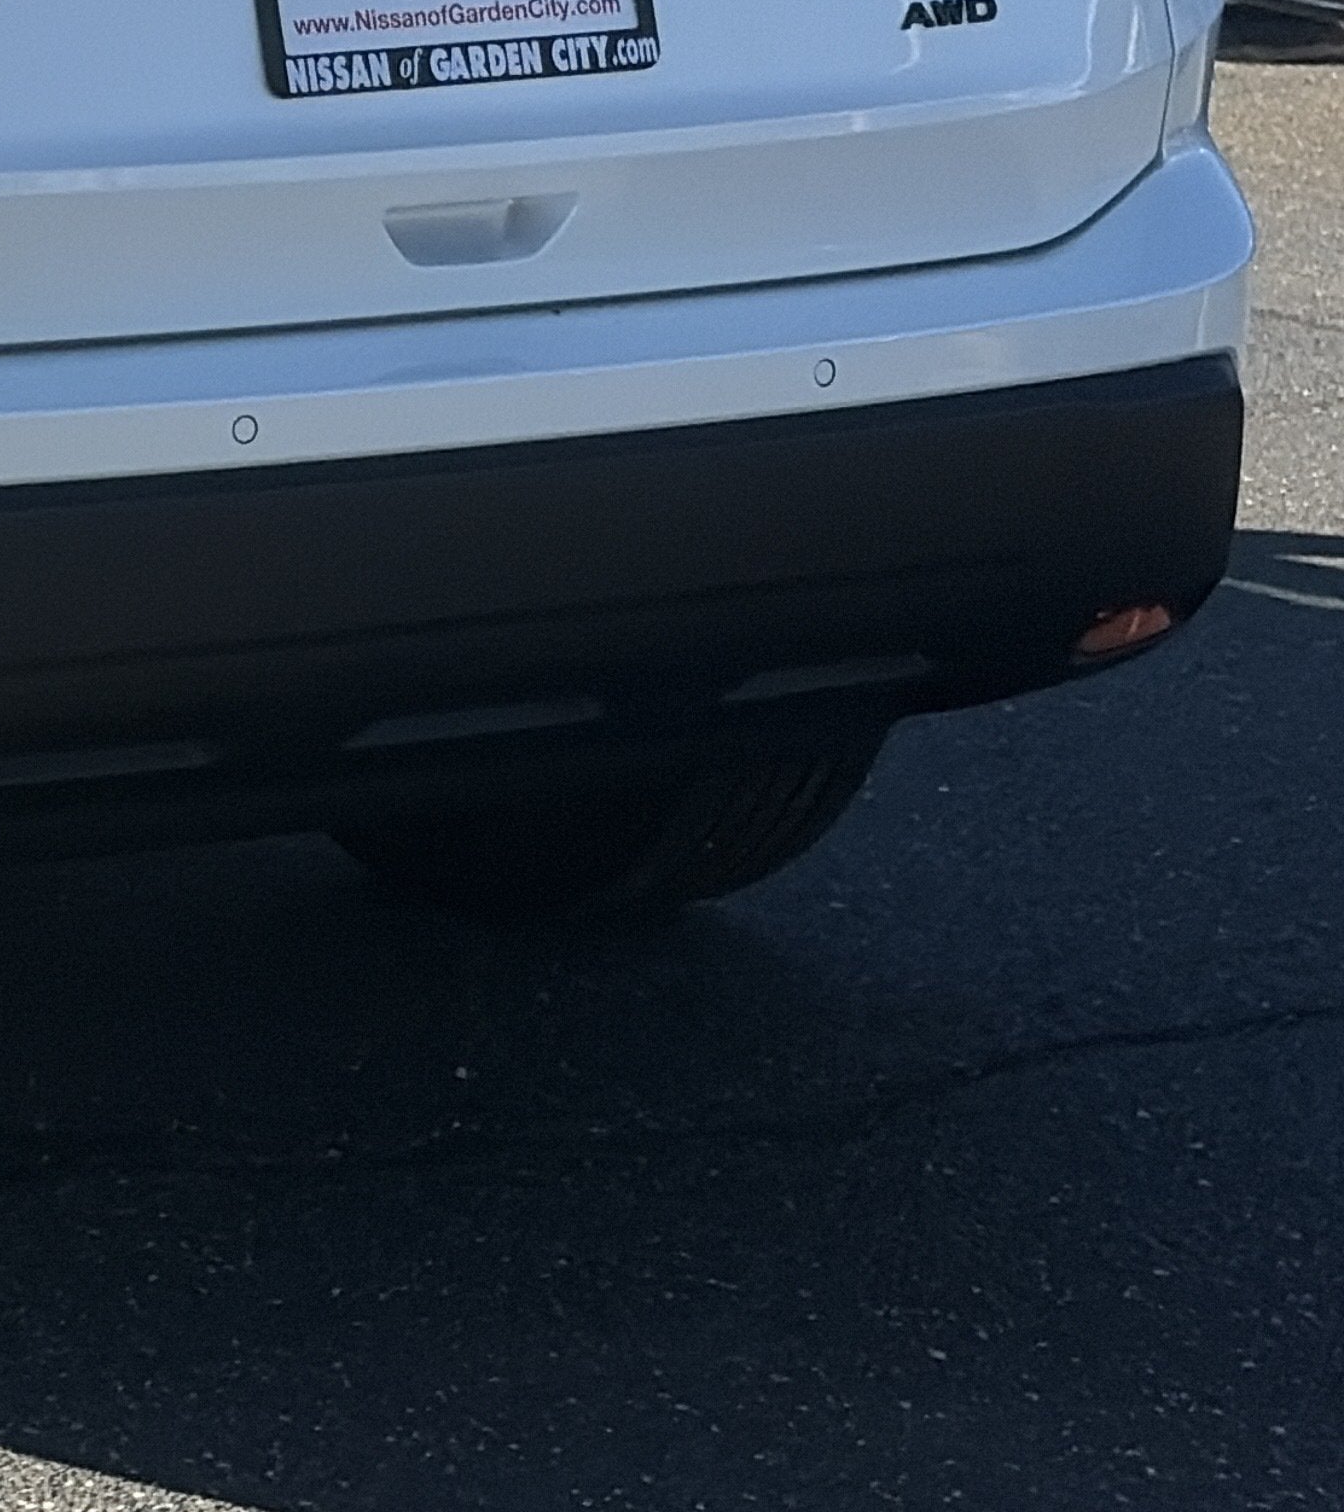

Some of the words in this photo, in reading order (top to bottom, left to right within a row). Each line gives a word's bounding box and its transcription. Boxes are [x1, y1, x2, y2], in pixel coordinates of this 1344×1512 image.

[286, 51, 392, 95] NISSAN
[399, 48, 425, 85] of
[429, 40, 543, 83] GARDEN
